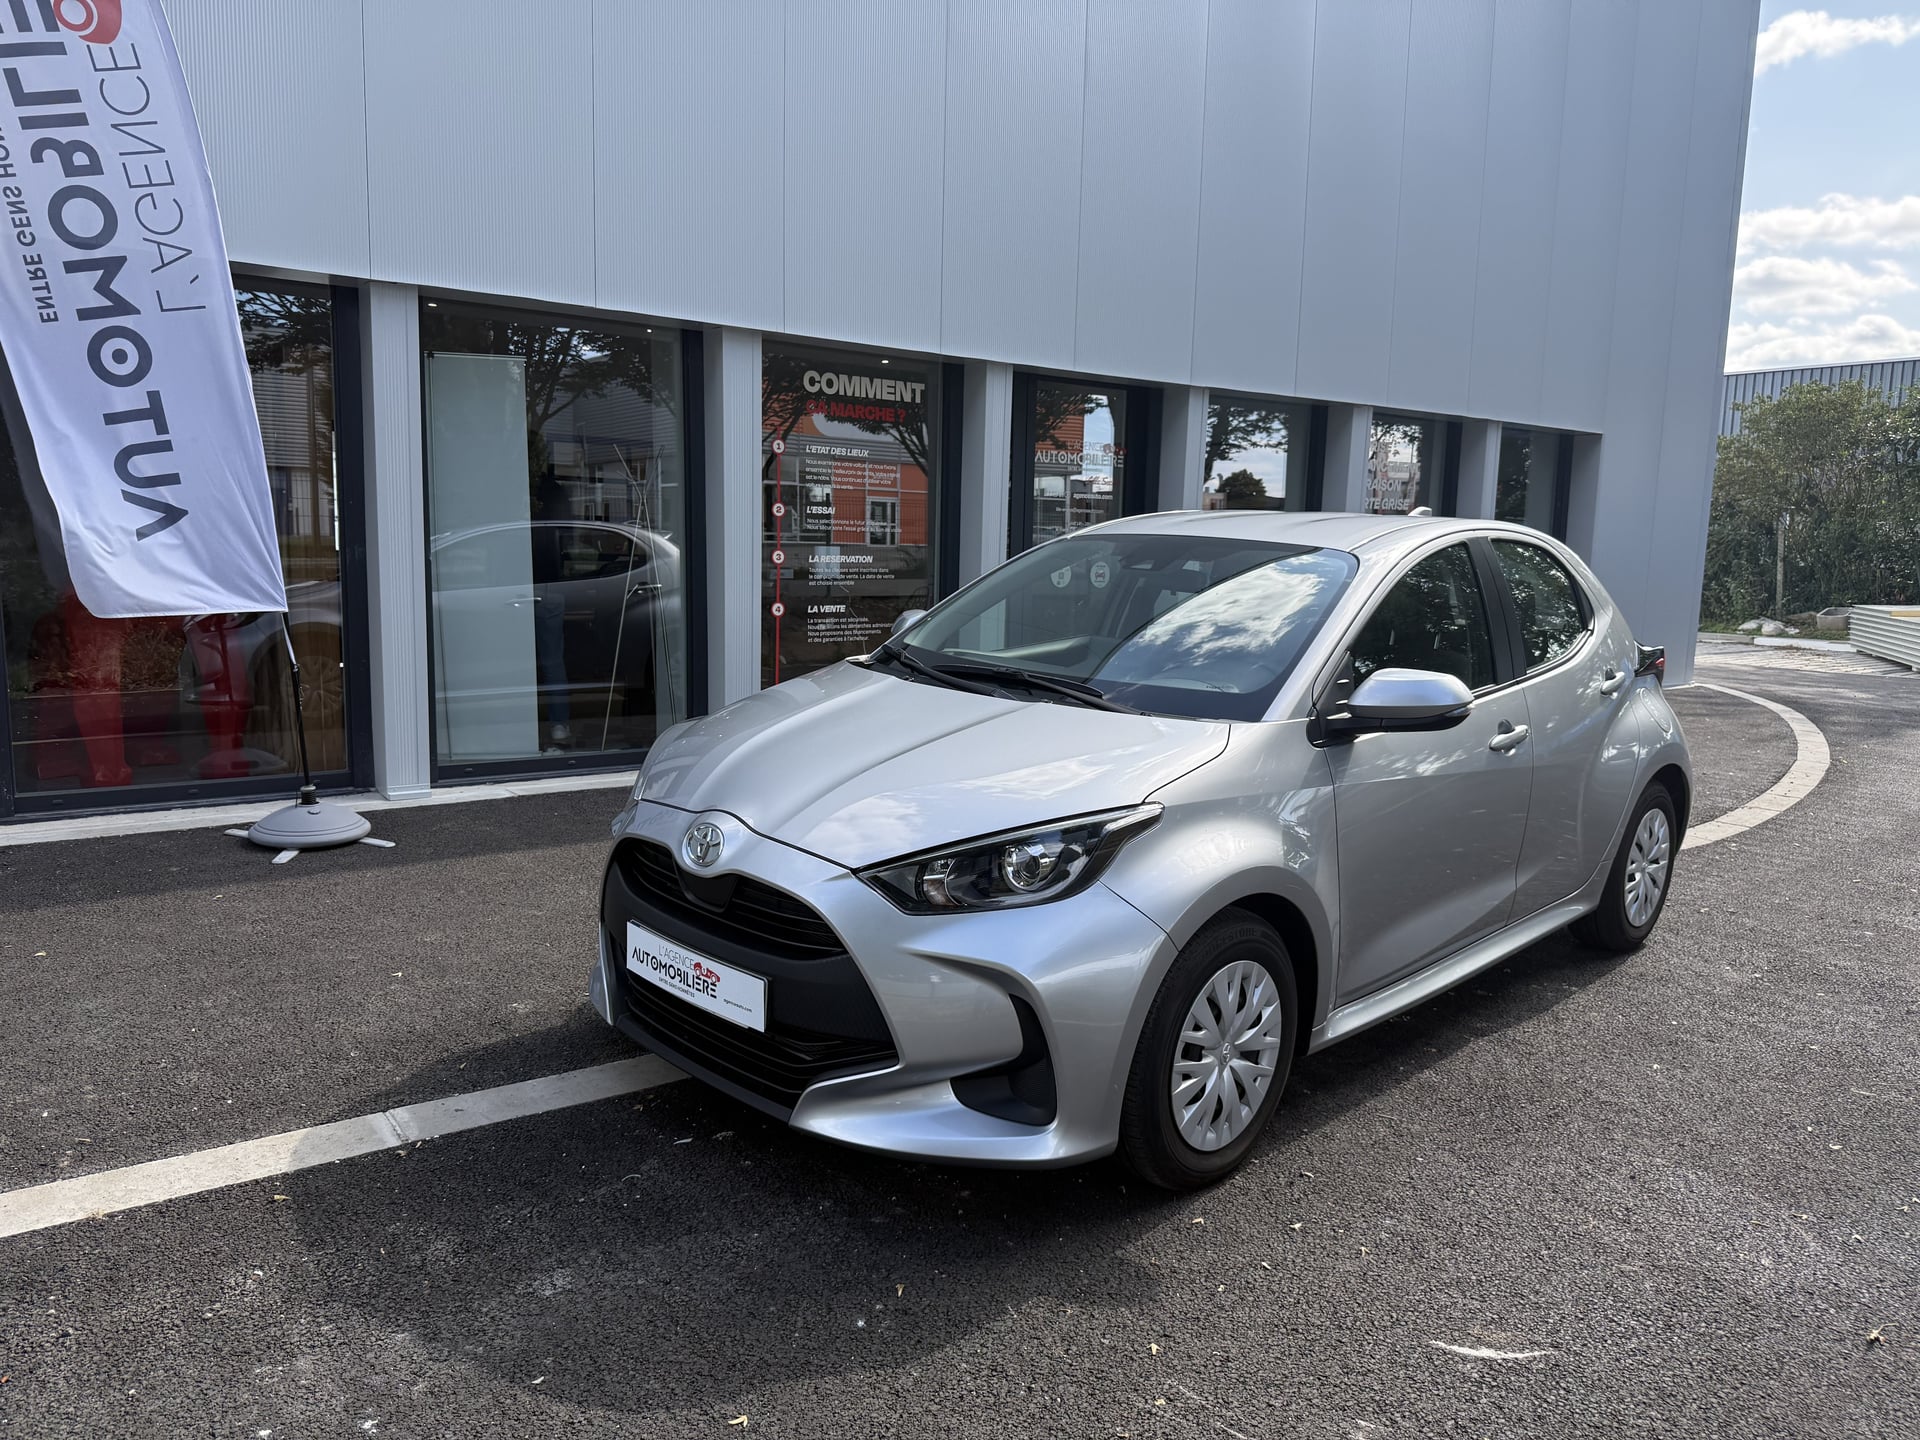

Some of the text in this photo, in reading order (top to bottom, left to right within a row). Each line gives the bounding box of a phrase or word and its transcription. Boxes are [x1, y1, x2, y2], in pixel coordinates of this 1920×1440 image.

[803, 370, 925, 404] COMMENT
[830, 401, 895, 422] MARCHE
[897, 408, 907, 423] ?
[805, 444, 870, 457] L'ETAT DES LIEUX
[806, 505, 836, 515] L'ESSAI
[1382, 498, 1410, 510] GRISE
[808, 555, 874, 564] LA RESERVATION
[807, 604, 846, 614] LA VENTE
[658, 944, 695, 971] L'AGENCE
